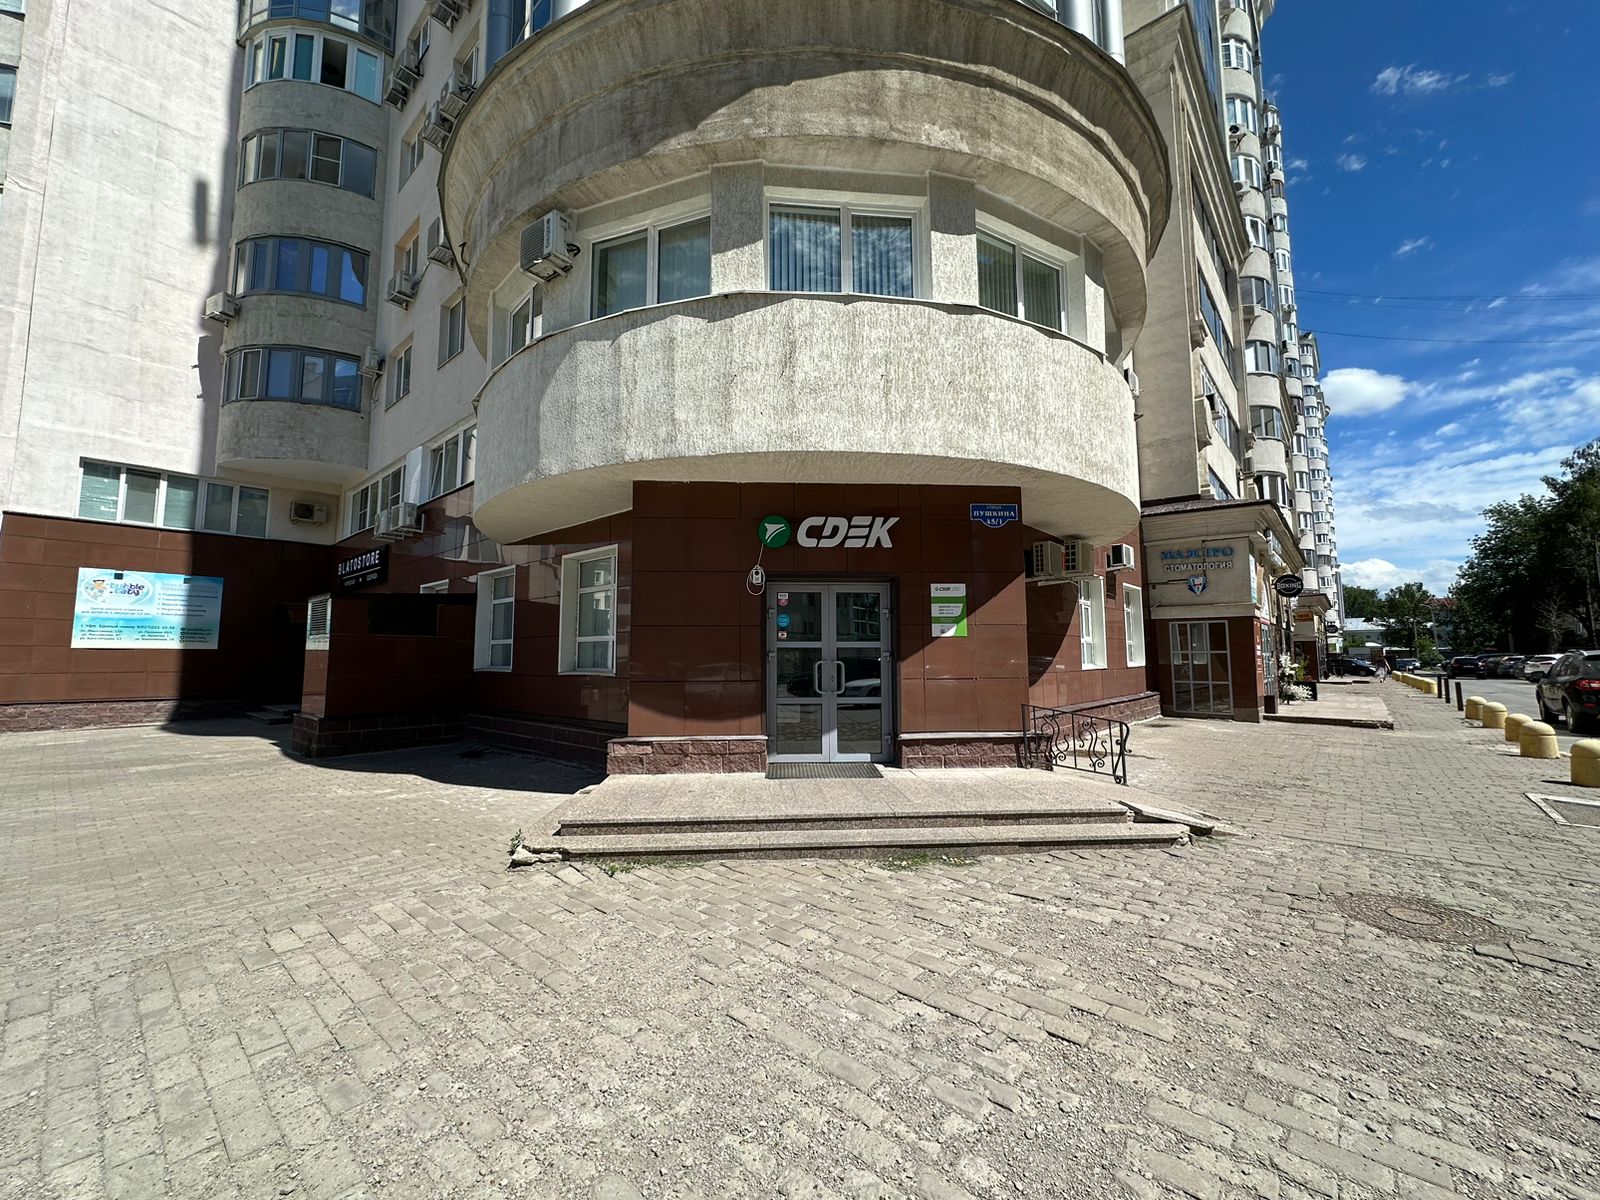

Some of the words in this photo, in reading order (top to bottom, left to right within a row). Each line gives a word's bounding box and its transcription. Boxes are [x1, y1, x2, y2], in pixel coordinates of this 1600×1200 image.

[796, 516, 900, 548] CDEK
[338, 550, 380, 575] BLATOSTORE
[1164, 561, 1233, 572] СТОМАТОЛОГИЯ
[1276, 581, 1302, 590] BOXING
